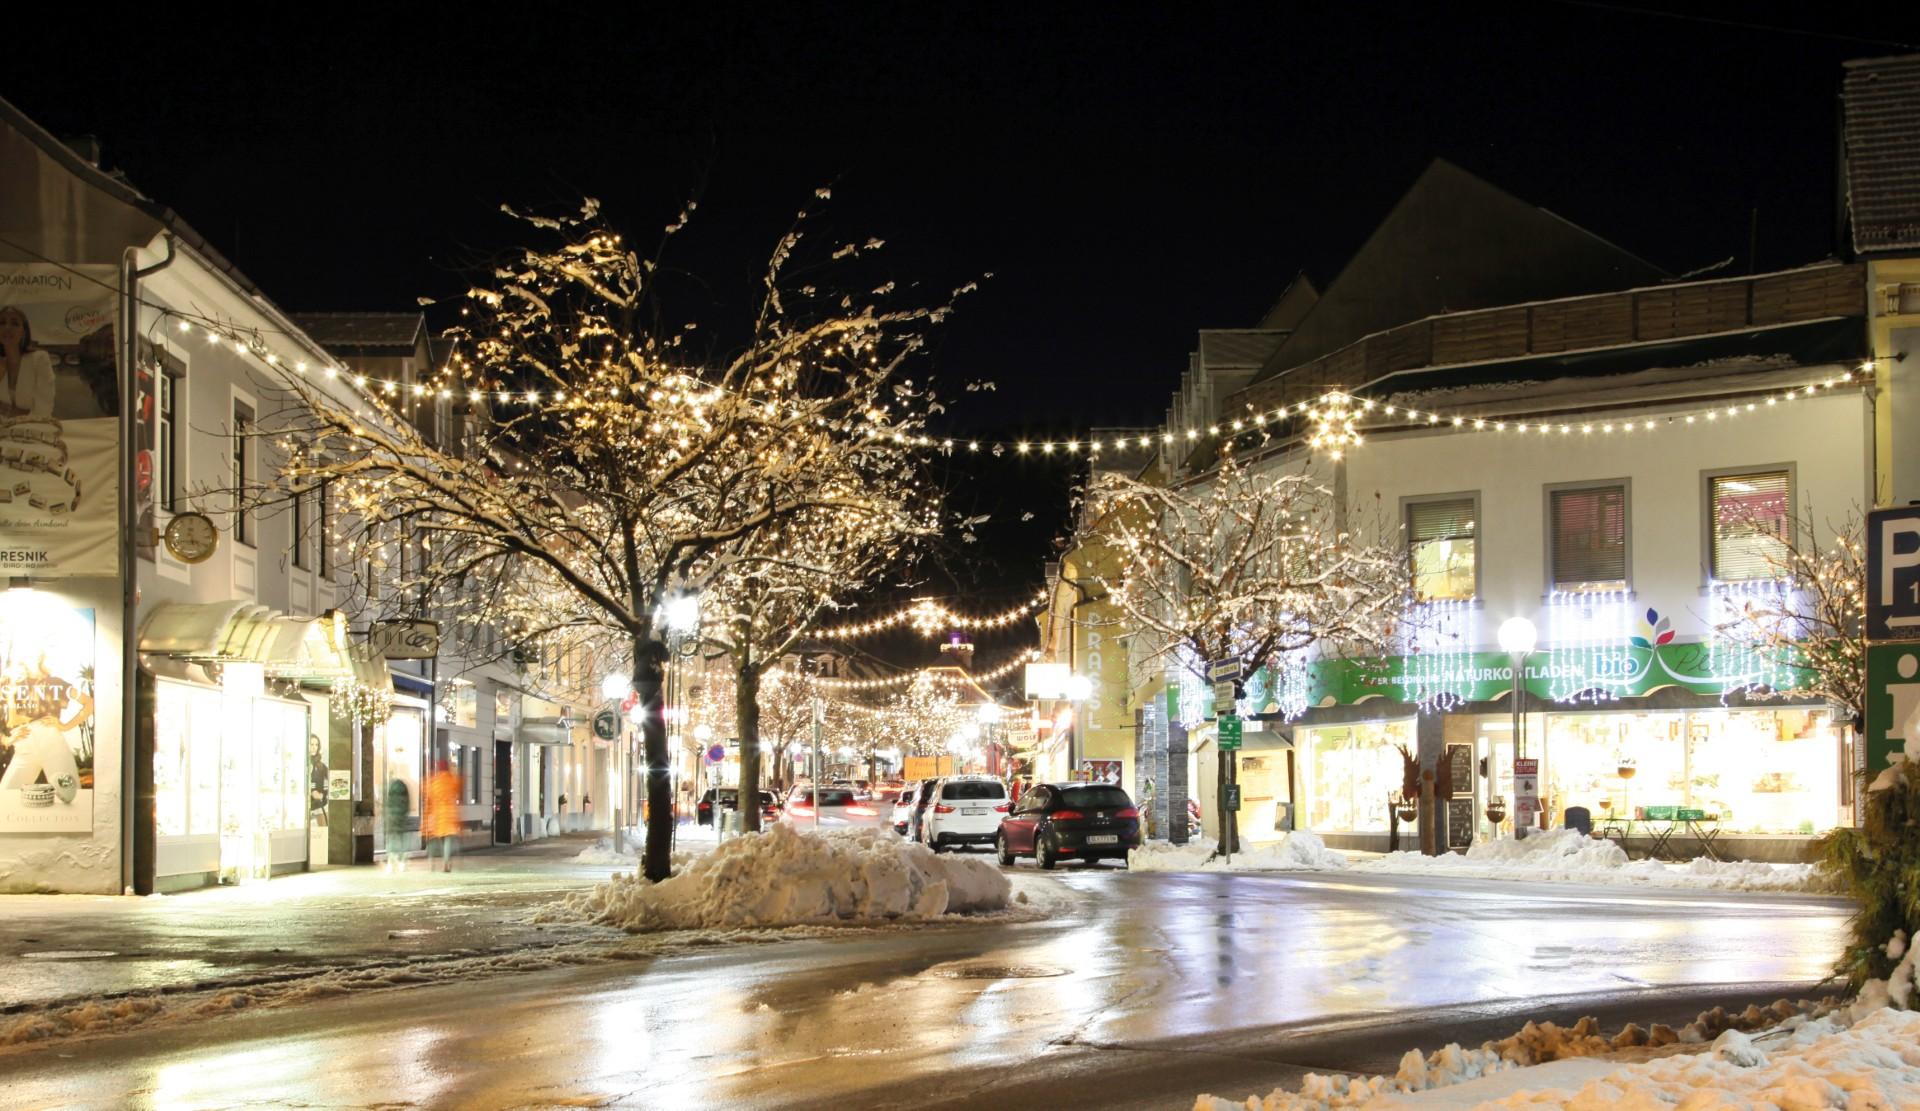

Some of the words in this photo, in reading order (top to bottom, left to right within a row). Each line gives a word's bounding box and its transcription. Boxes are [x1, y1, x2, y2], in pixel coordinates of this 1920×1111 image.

[1881, 517, 1920, 607] P
[1444, 664, 1584, 682] NATURKOTLADEN
[1592, 650, 1640, 677] bio
